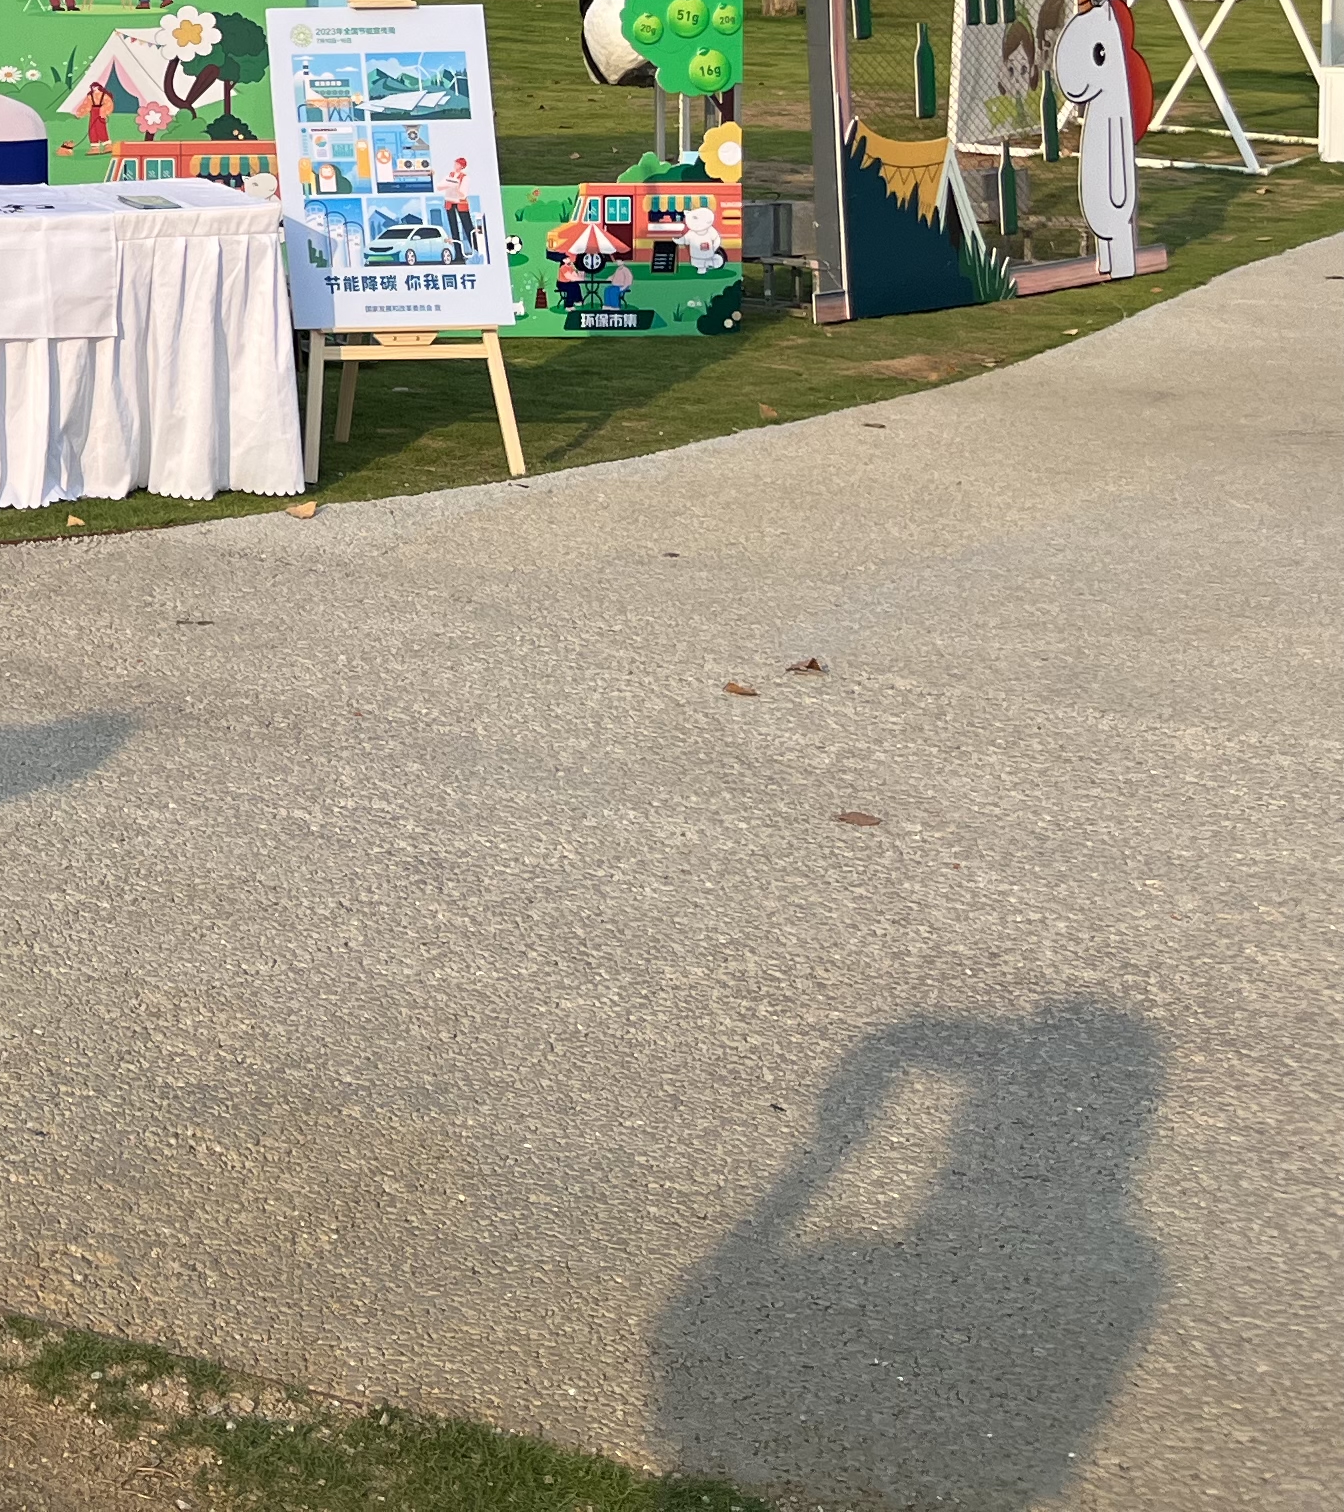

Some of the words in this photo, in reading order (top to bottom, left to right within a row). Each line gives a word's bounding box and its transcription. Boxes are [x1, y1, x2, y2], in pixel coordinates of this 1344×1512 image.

[676, 9, 700, 25] 51g
[699, 65, 722, 78] 16g
[324, 274, 398, 294] 节能降碳
[404, 273, 477, 291] 你我同行
[580, 313, 638, 328] 环保市集
